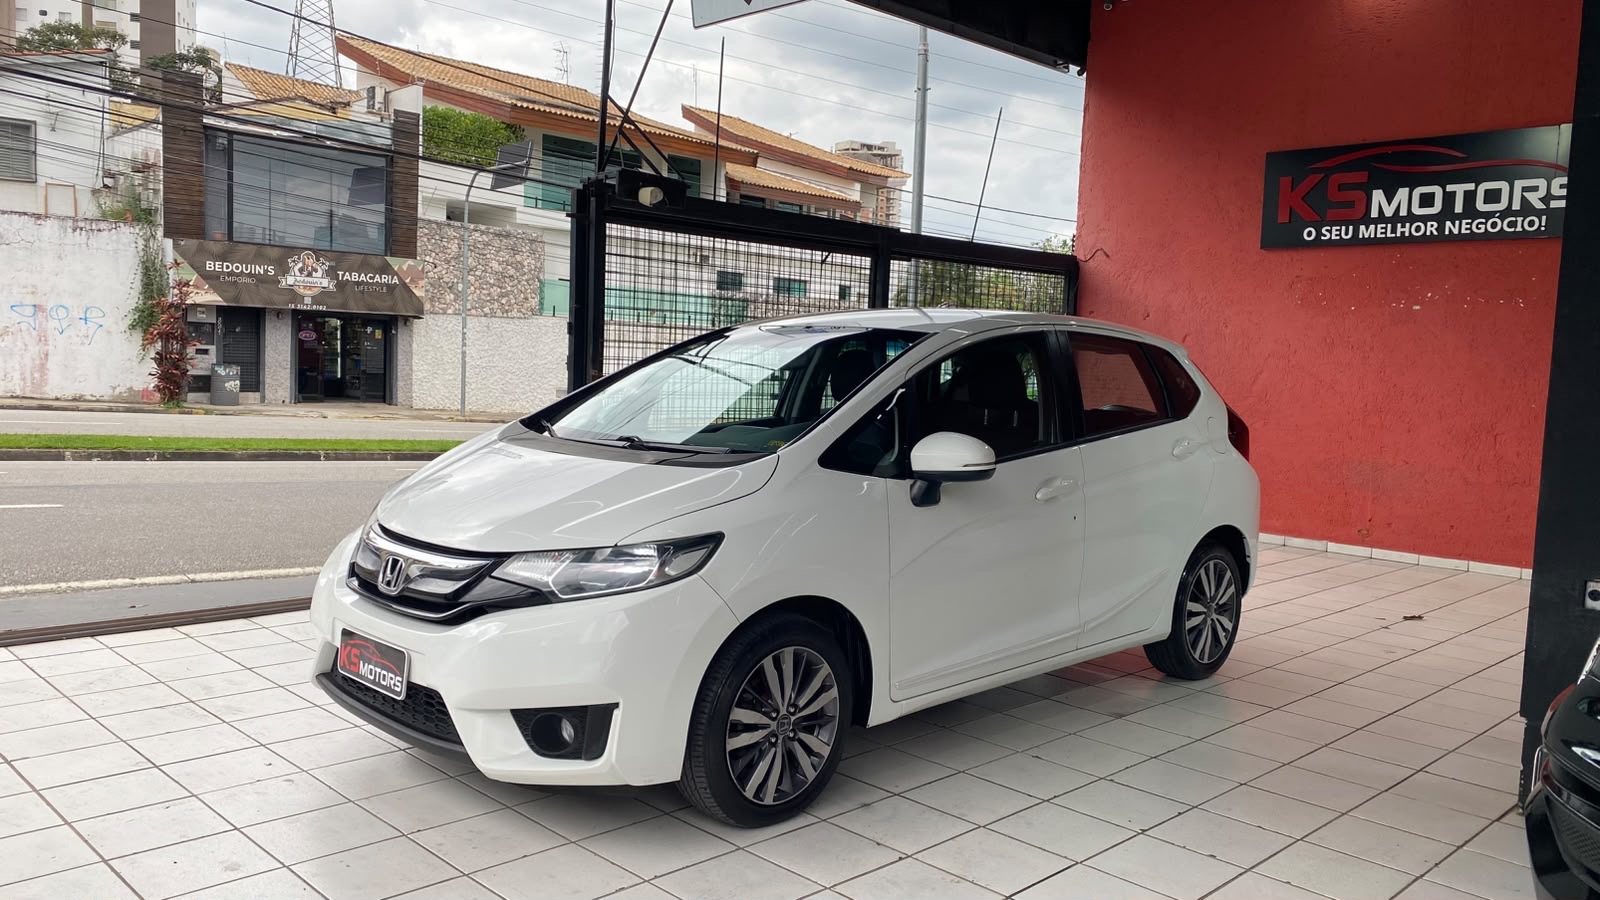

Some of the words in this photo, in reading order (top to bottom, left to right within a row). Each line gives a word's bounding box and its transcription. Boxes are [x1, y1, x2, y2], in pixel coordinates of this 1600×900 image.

[1303, 226, 1317, 240] O
[1321, 225, 1353, 240] SEU
[1358, 221, 1438, 239] MELHOR
[1445, 213, 1547, 235] NEGÓCIO!
[205, 260, 275, 276] BEDOUIN'S
[220, 275, 256, 284] EMPORIO
[337, 271, 399, 285] TABACARIA
[354, 285, 388, 293] LIFESTYLE
[359, 660, 402, 692] MOTORS
